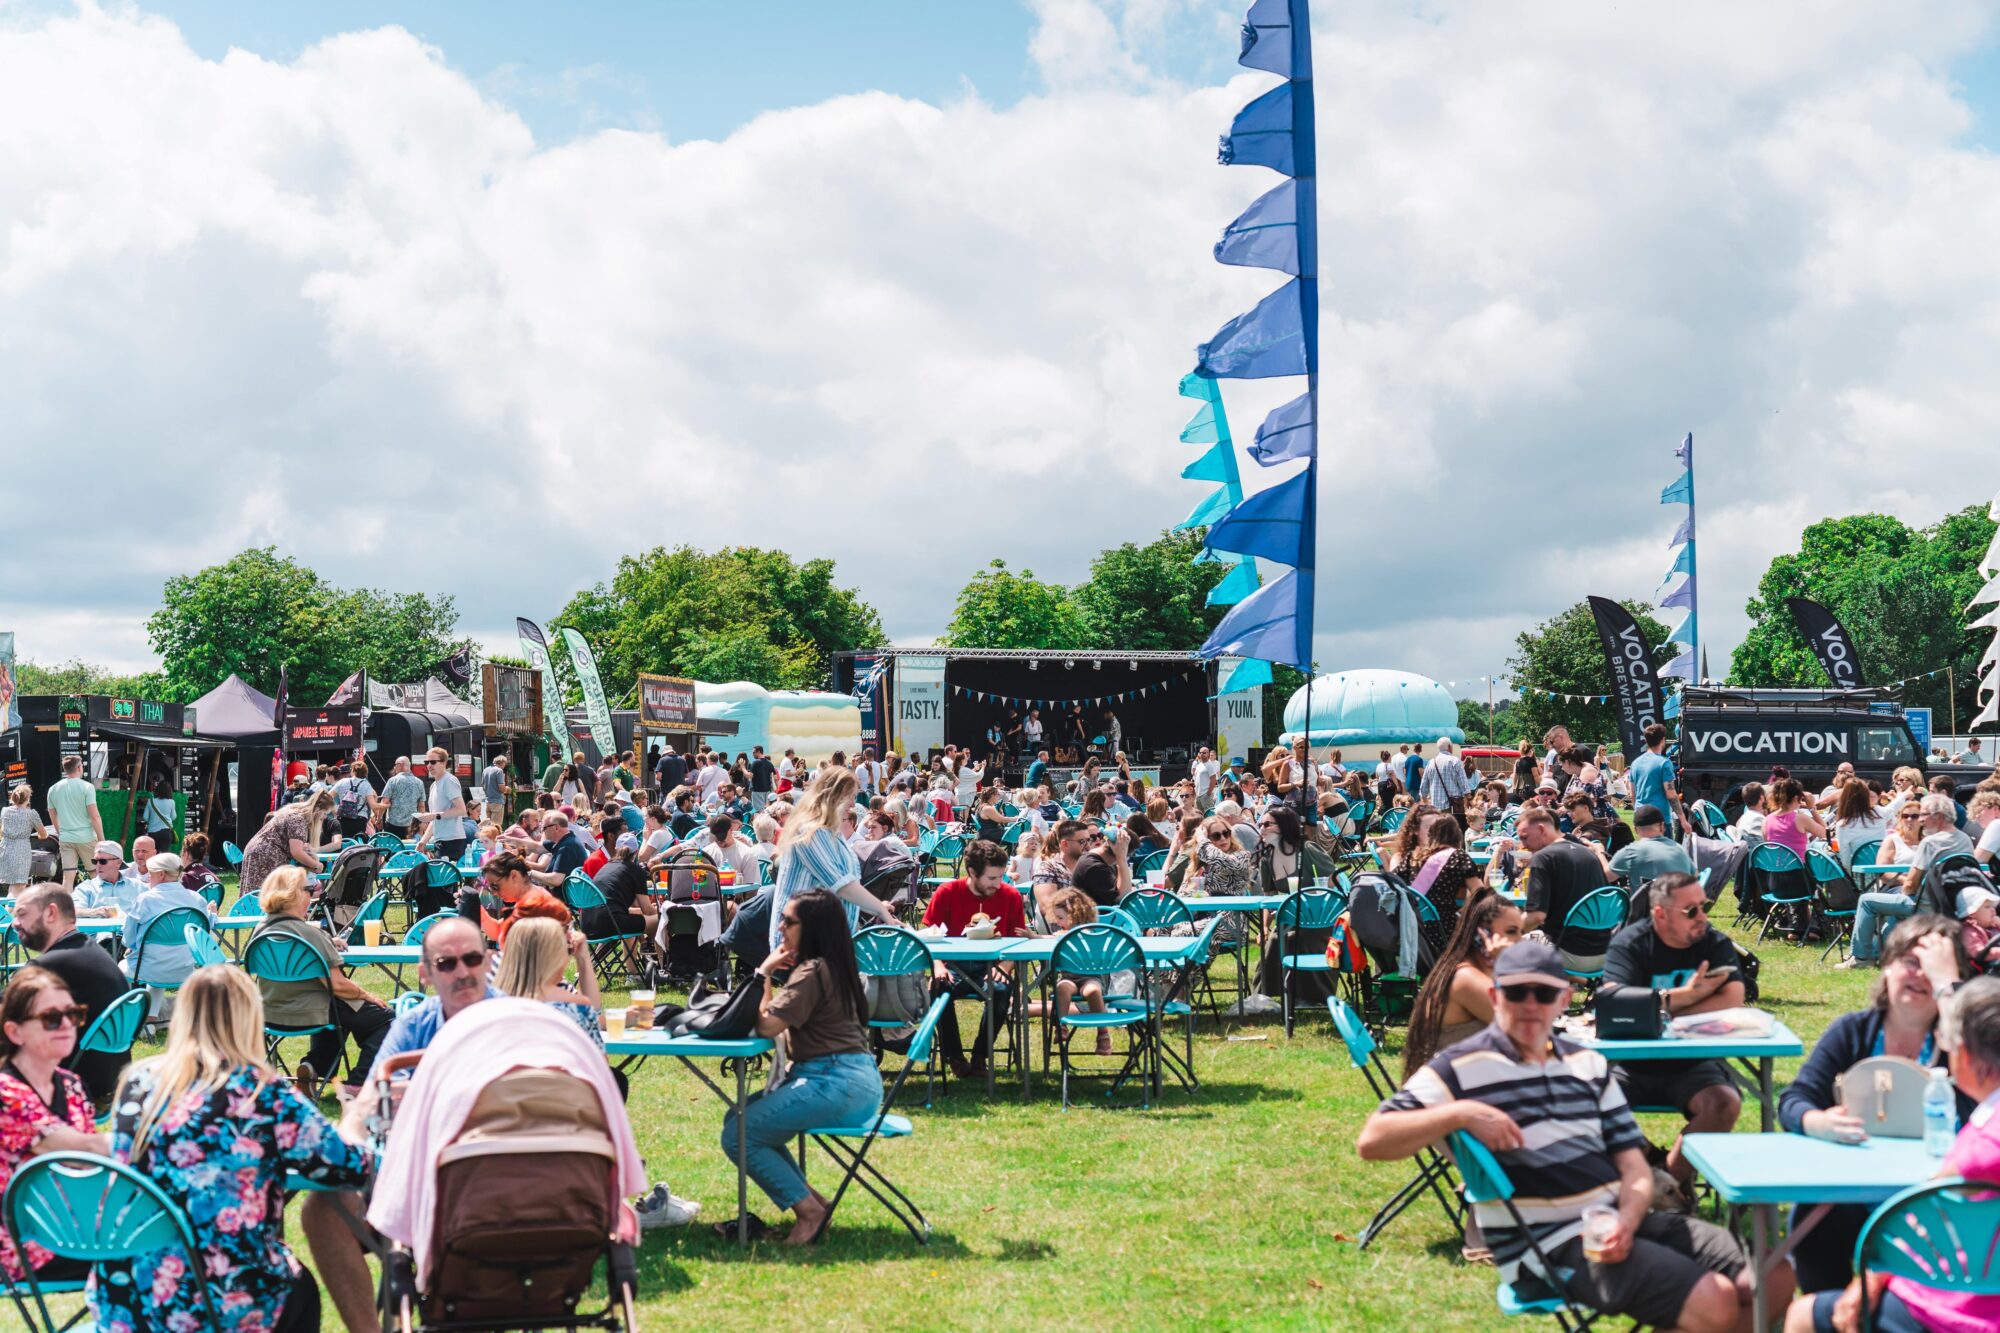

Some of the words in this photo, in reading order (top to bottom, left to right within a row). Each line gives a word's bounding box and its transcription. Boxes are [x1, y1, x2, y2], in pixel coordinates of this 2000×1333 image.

[1612, 655, 1635, 725] BREWERY
[143, 703, 163, 721] THAI
[900, 700, 941, 720] TASTY.
[1227, 700, 1257, 719] YUM.
[292, 726, 319, 739] JAPANESE
[320, 725, 338, 737] STREET
[340, 725, 353, 737] FOOD
[1688, 731, 1848, 754] VOCATION
